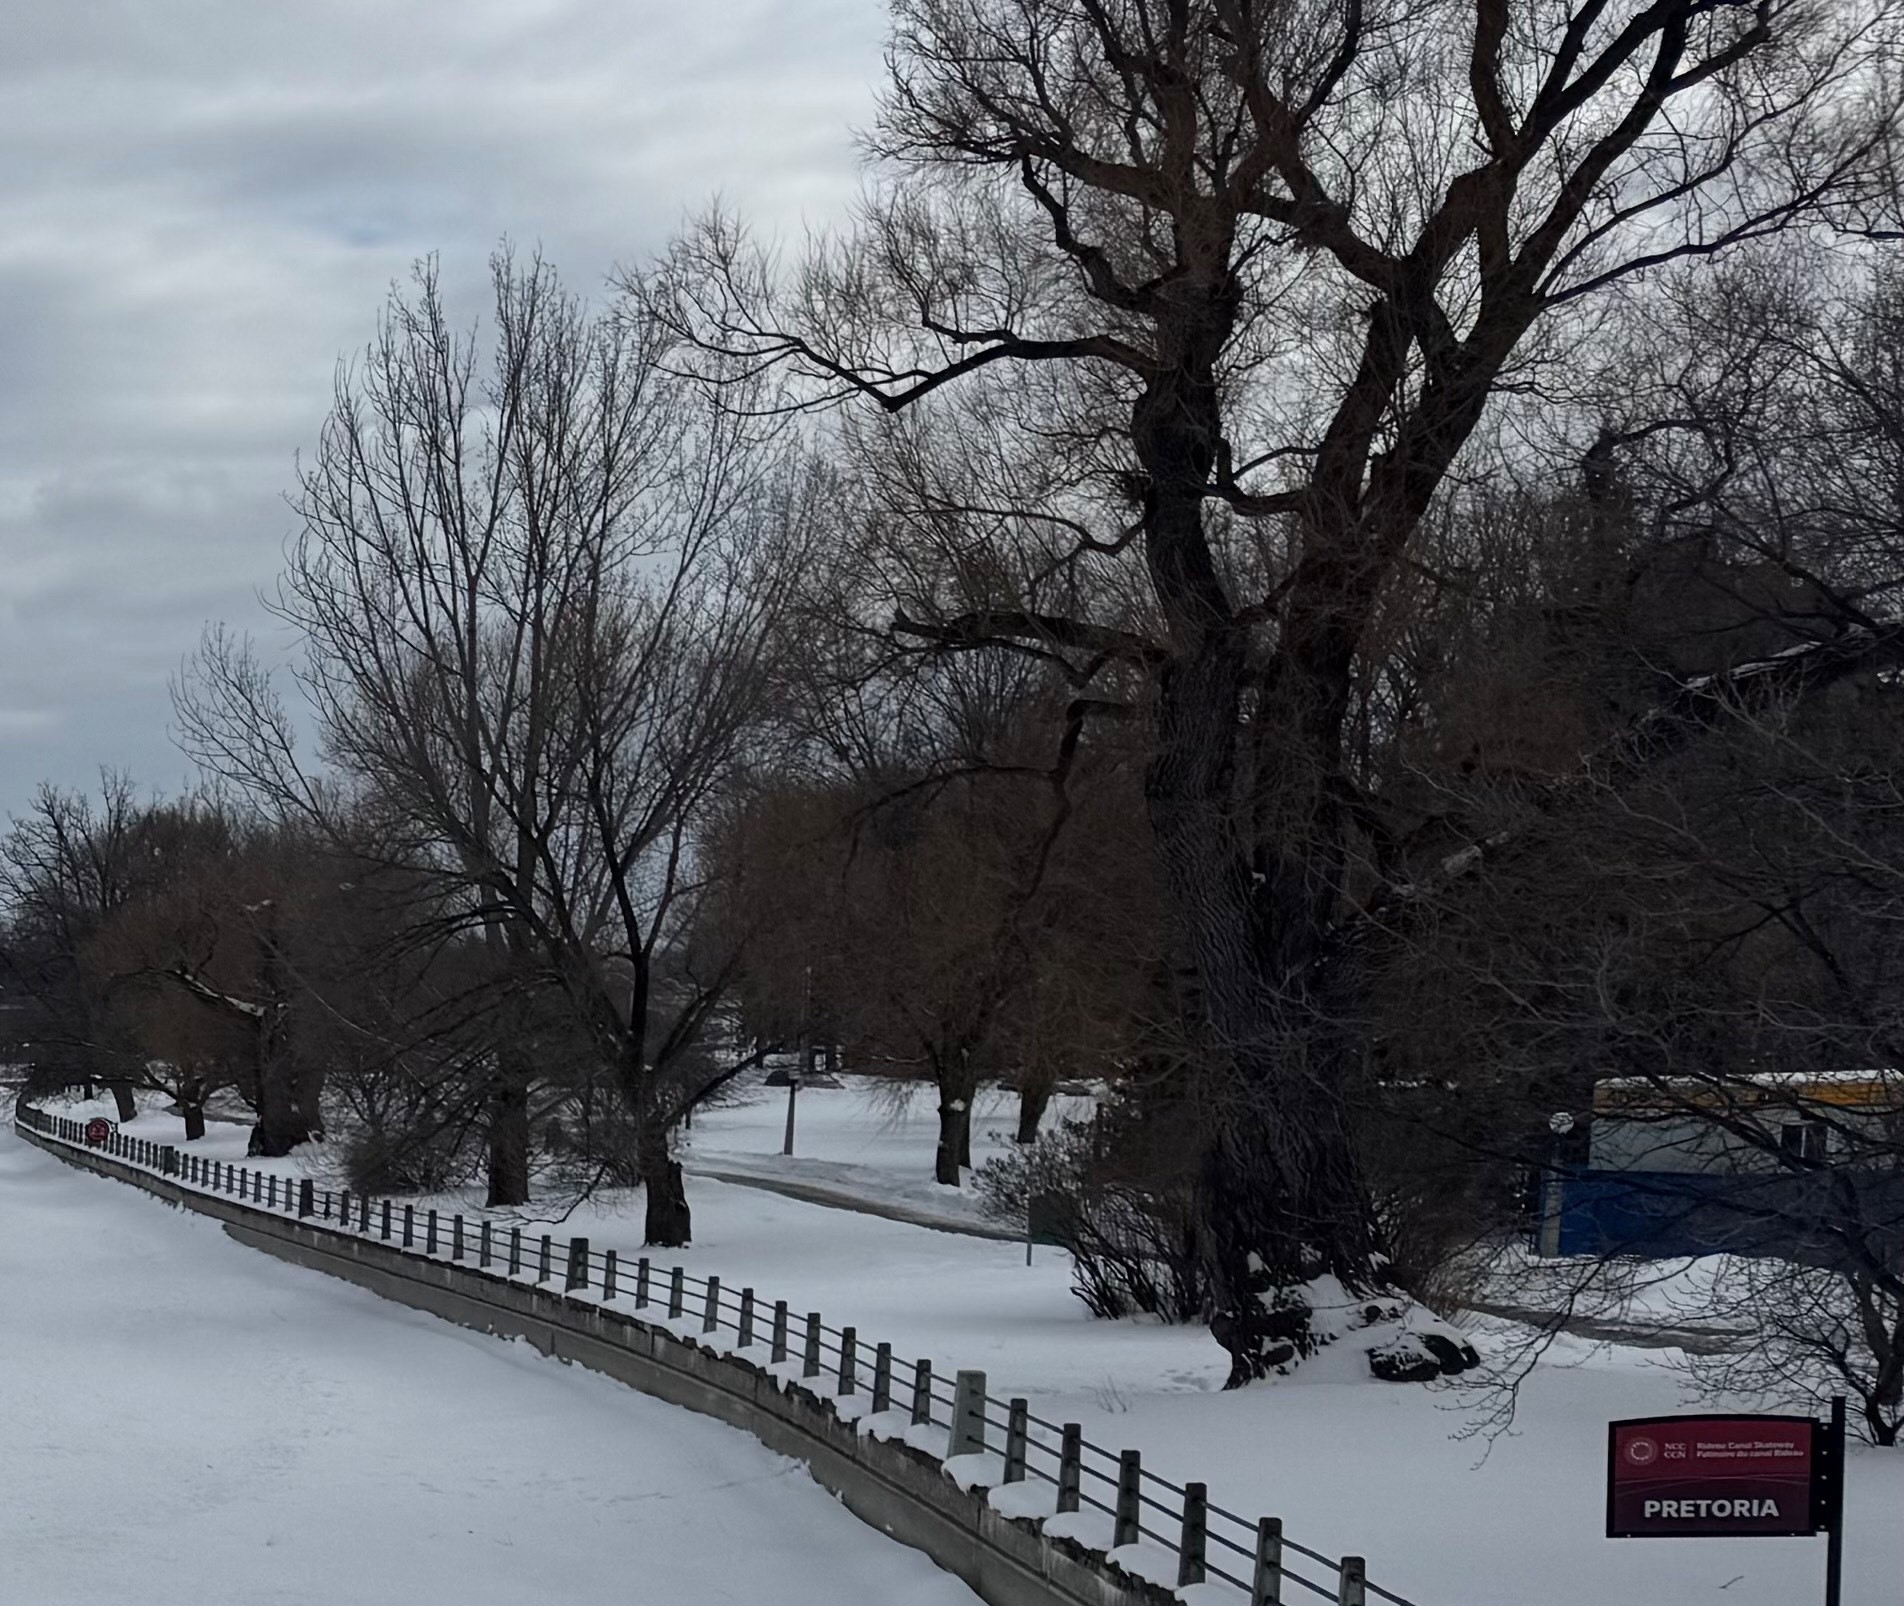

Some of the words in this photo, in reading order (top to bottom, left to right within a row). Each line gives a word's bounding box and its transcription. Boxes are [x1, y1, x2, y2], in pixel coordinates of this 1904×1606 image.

[1664, 1442, 1687, 1450] NCC
[1663, 1450, 1687, 1459] CCN
[1644, 1499, 1780, 1518] PRETORIA
